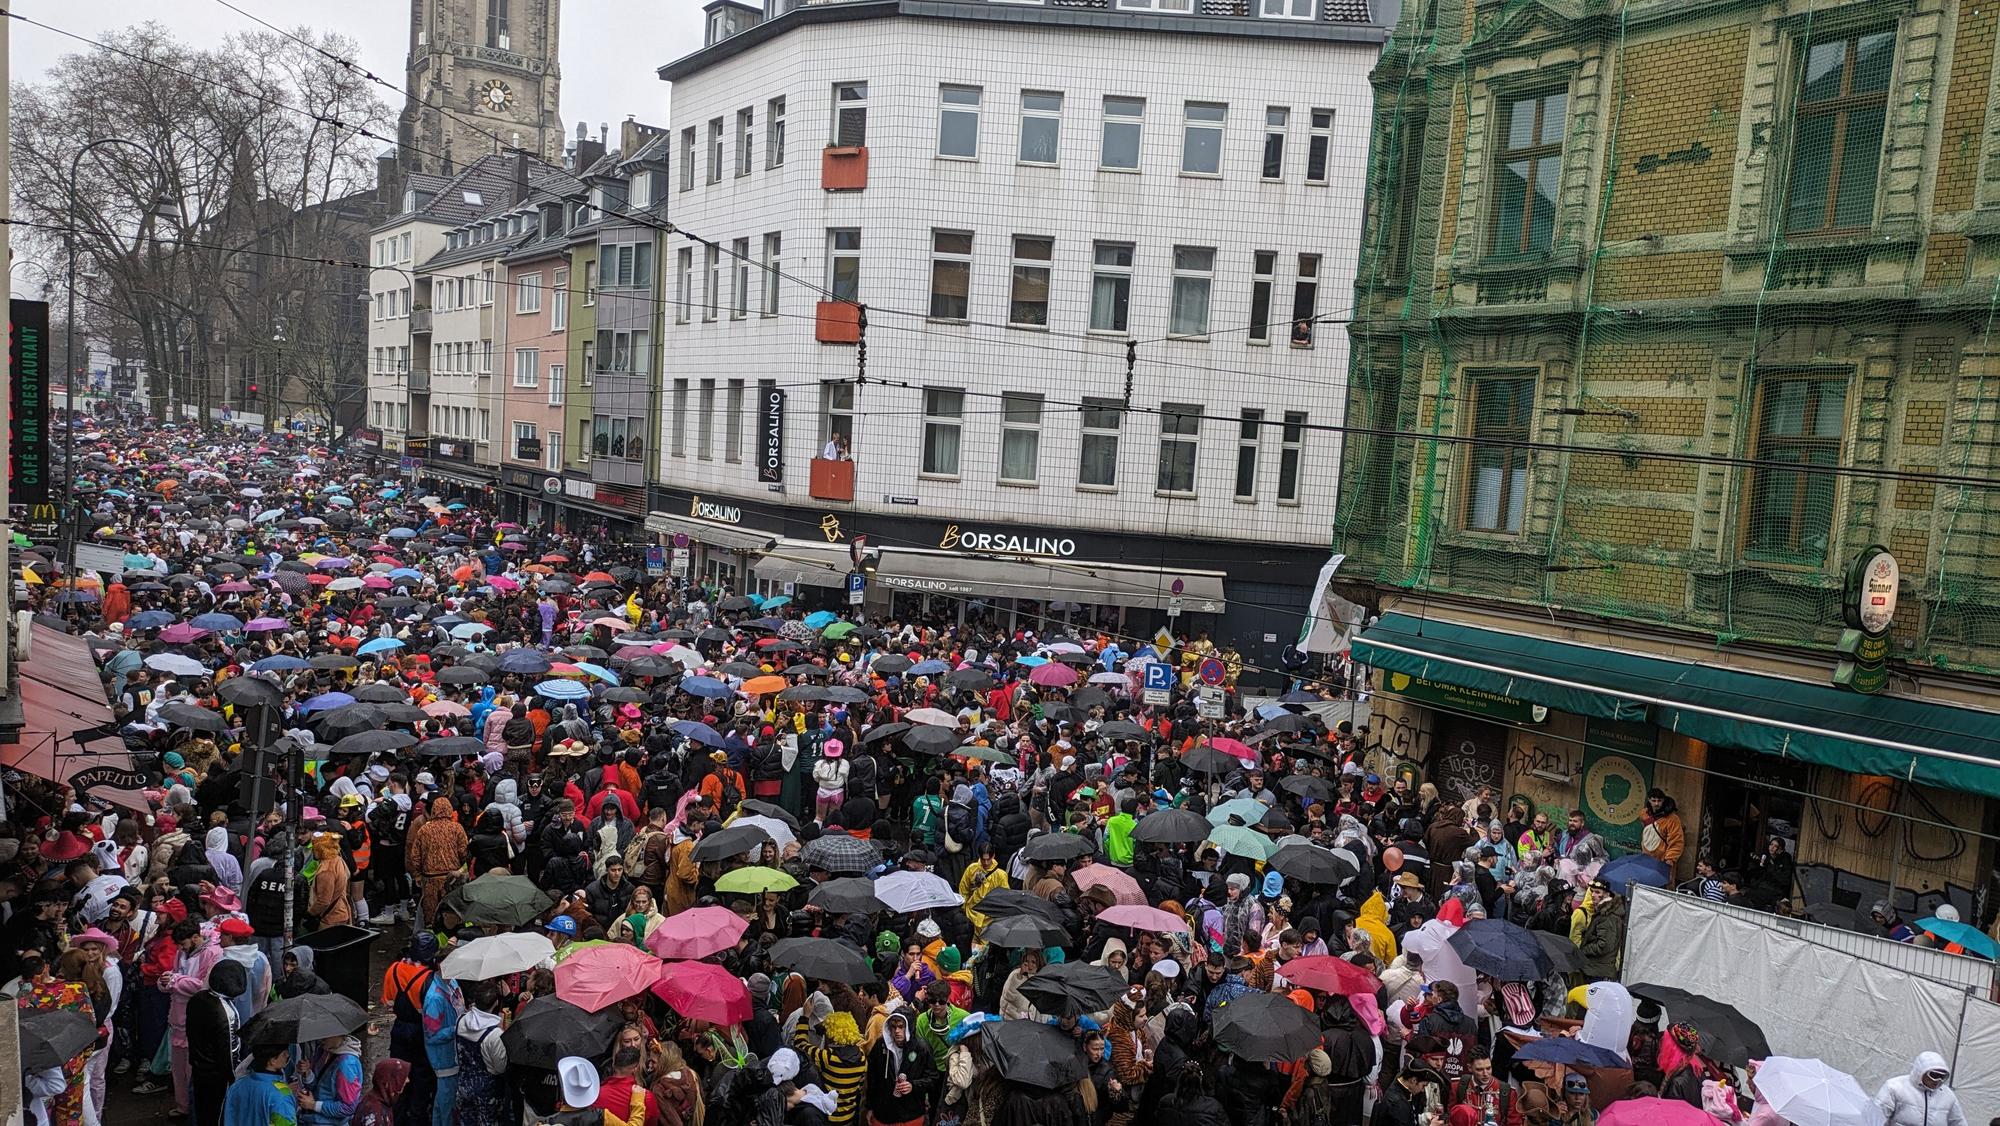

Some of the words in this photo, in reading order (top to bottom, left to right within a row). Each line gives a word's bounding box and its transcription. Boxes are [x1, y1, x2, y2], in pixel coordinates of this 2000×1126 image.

[22, 326, 38, 407] RESTAURANT
[22, 418, 38, 443] BAR
[763, 392, 781, 480] BORSALINO
[19, 453, 38, 485] CAFÉ
[691, 495, 741, 523] BORSALINO
[939, 524, 1076, 556] BORSALINO
[853, 576, 862, 590] P
[885, 577, 947, 591] BORSALINO
[1863, 639, 1873, 648] BEI
[1873, 639, 1886, 648] OMA
[1148, 666, 1163, 686] P
[811, 741, 824, 757] 11
[78, 770, 147, 787] PAPELITO
[922, 805, 931, 824] 7
[260, 880, 286, 892] SEK
